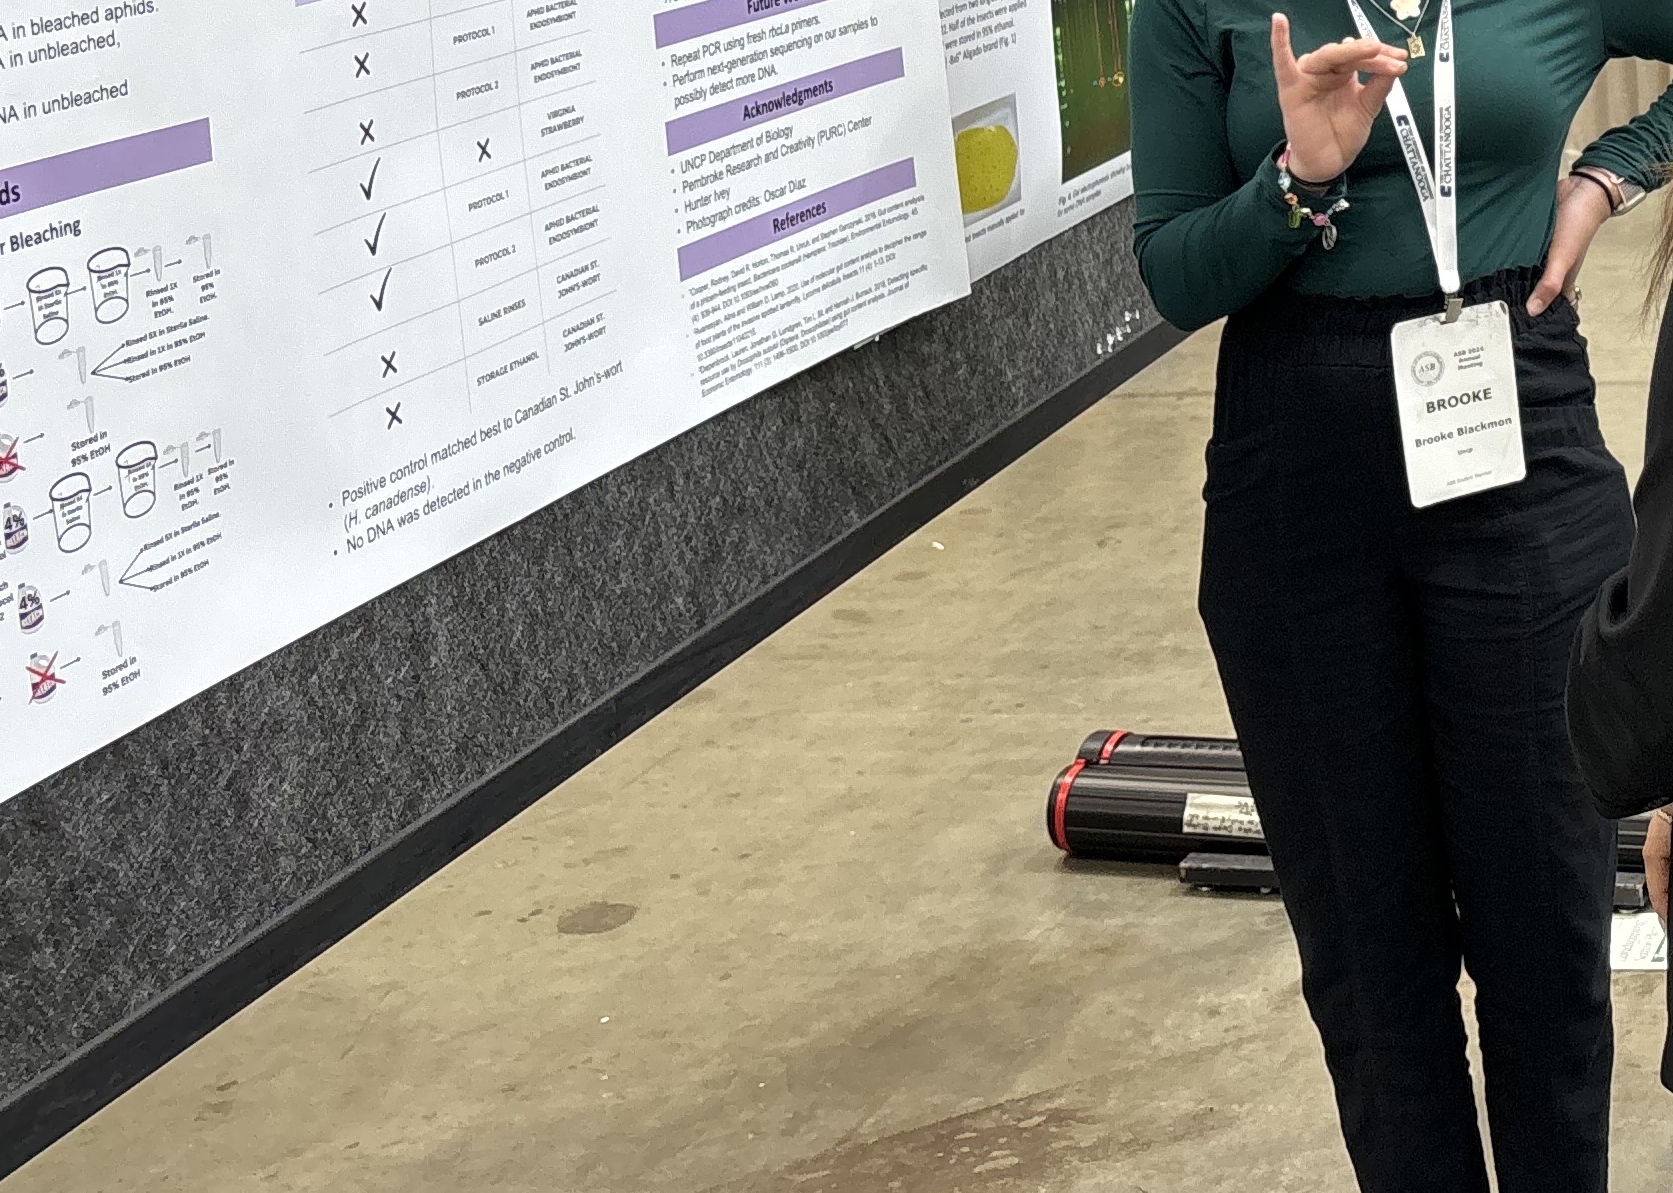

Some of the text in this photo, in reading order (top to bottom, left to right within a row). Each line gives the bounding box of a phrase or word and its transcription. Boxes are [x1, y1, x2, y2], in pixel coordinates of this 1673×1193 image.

[743, 79, 834, 122] Acknowledgments
[680, 125, 794, 175] UNCP Department of Biology
[772, 201, 827, 234] References
[1425, 387, 1493, 414] BROOKE
[341, 360, 624, 507] Positive control matched best to Canadian St. John's-wort
[1414, 417, 1513, 448] Brooke Blackmon
[343, 477, 434, 534] (H. canadense).
[346, 427, 577, 554] No DNA was detected in the negative control.
